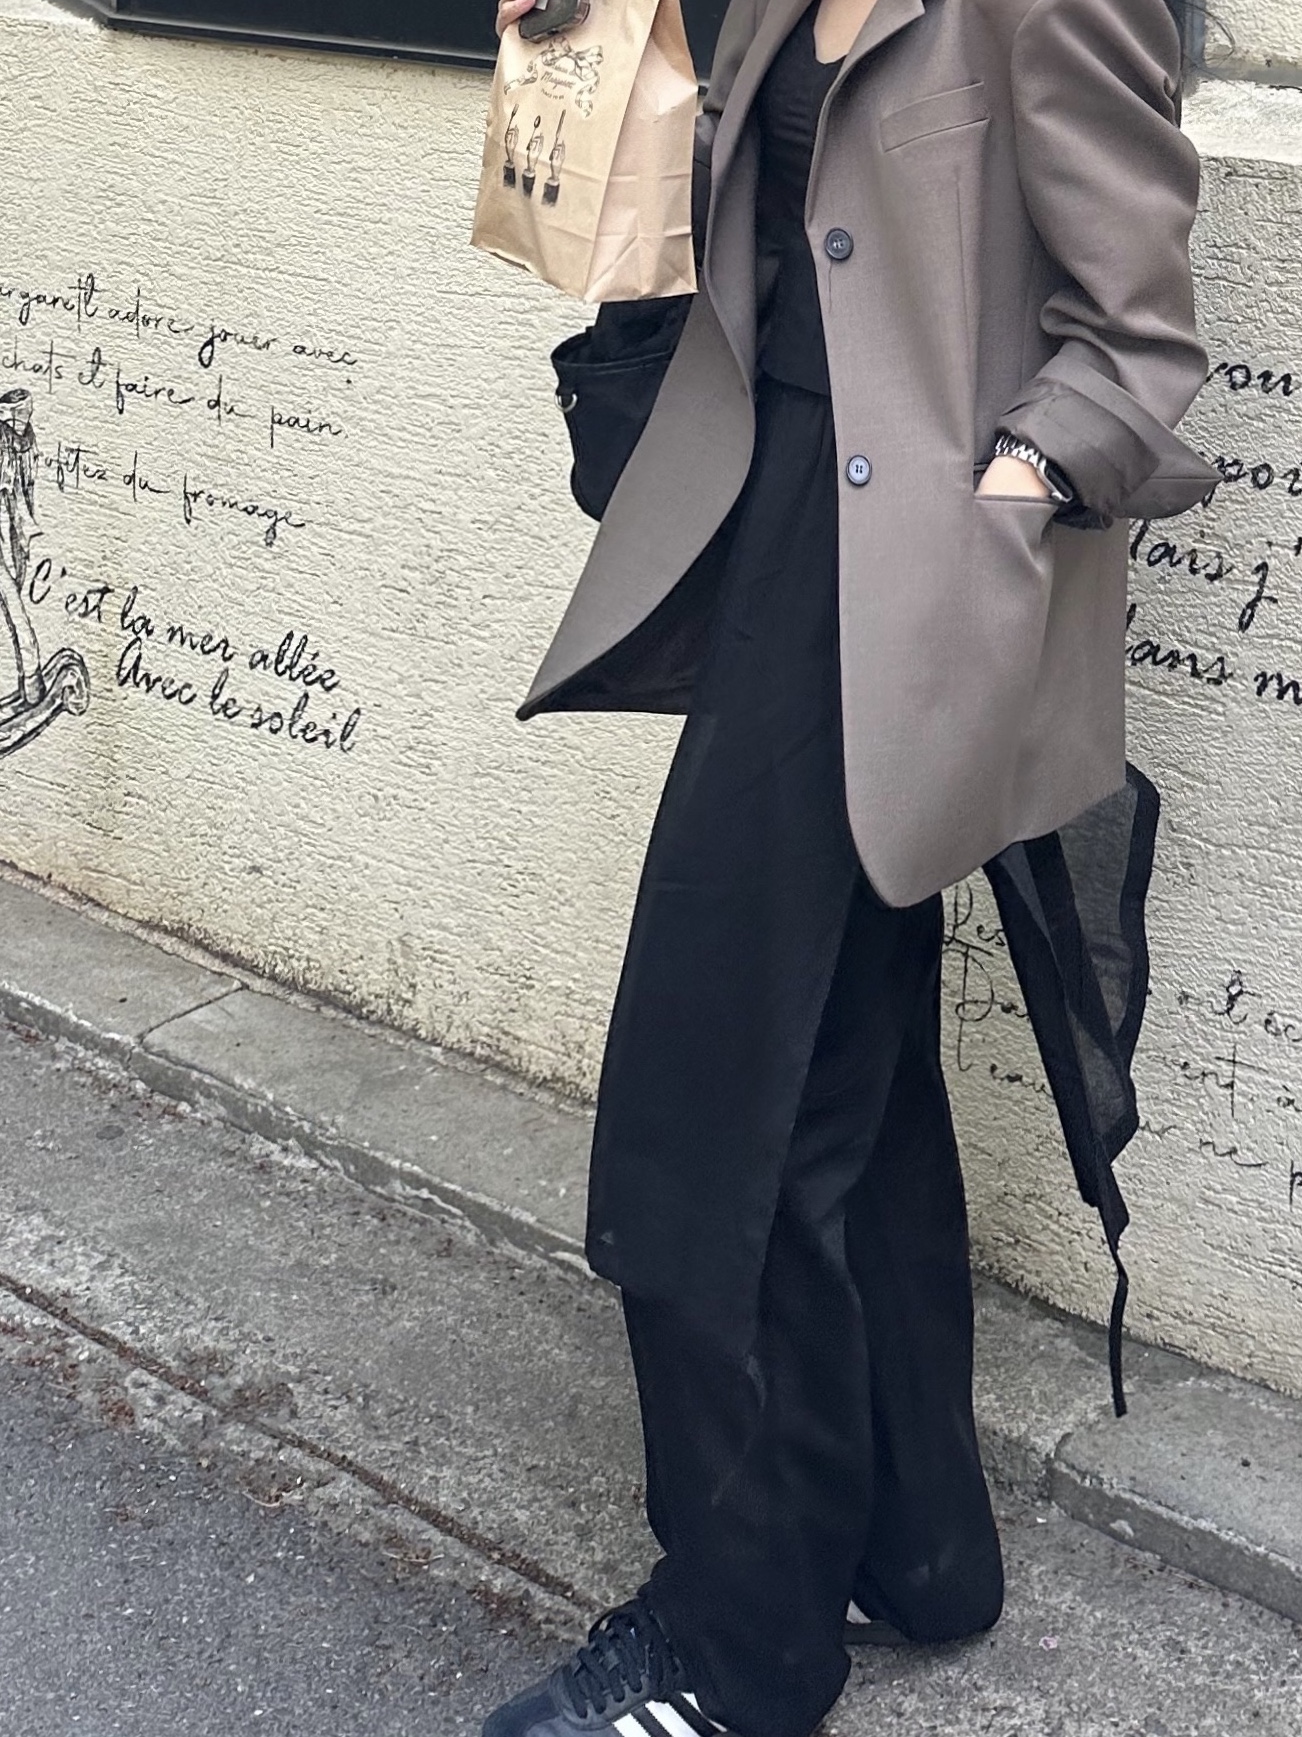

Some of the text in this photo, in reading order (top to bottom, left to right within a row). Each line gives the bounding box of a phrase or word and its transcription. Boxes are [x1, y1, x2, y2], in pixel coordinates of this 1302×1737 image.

[108, 287, 194, 338] adore
[198, 319, 278, 368] jouer
[293, 344, 358, 365] avec
[116, 362, 195, 415] faire
[207, 374, 256, 425] du
[123, 451, 170, 503] du
[182, 473, 305, 547] fromage
[28, 558, 340, 692] C'est la mer allée
[1126, 603, 1233, 685] ans
[115, 637, 362, 753] Avec le soleil
